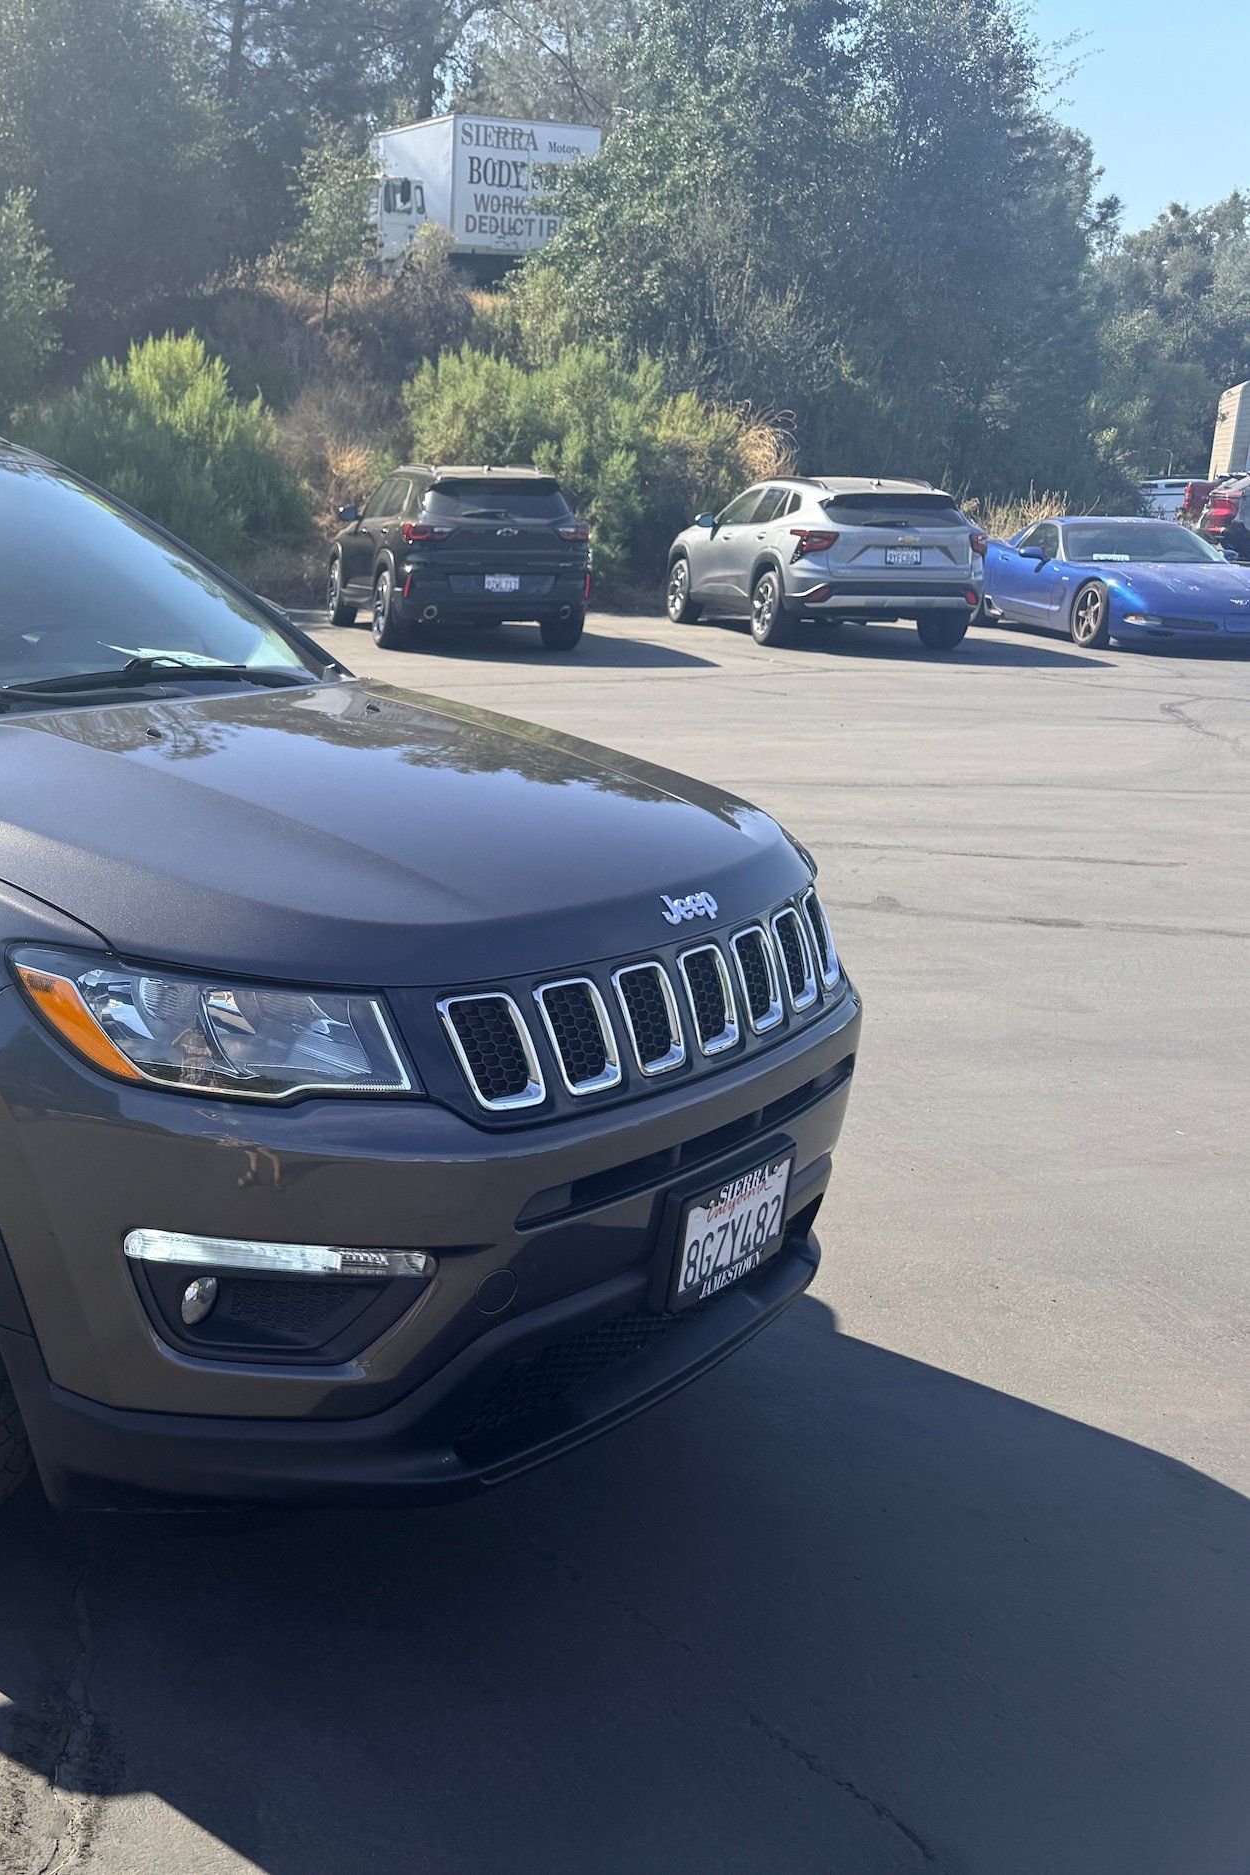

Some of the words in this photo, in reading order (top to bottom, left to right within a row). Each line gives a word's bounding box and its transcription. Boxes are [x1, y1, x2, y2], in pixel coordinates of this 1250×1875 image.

[461, 122, 538, 151] SIERRA
[548, 141, 581, 154] Motors
[467, 156, 528, 190] BODY
[659, 891, 718, 925] Jeep
[718, 1164, 770, 1204] SIERRA
[683, 1194, 782, 1290] 8GZY482
[698, 1248, 764, 1300] JAMESTOWN
